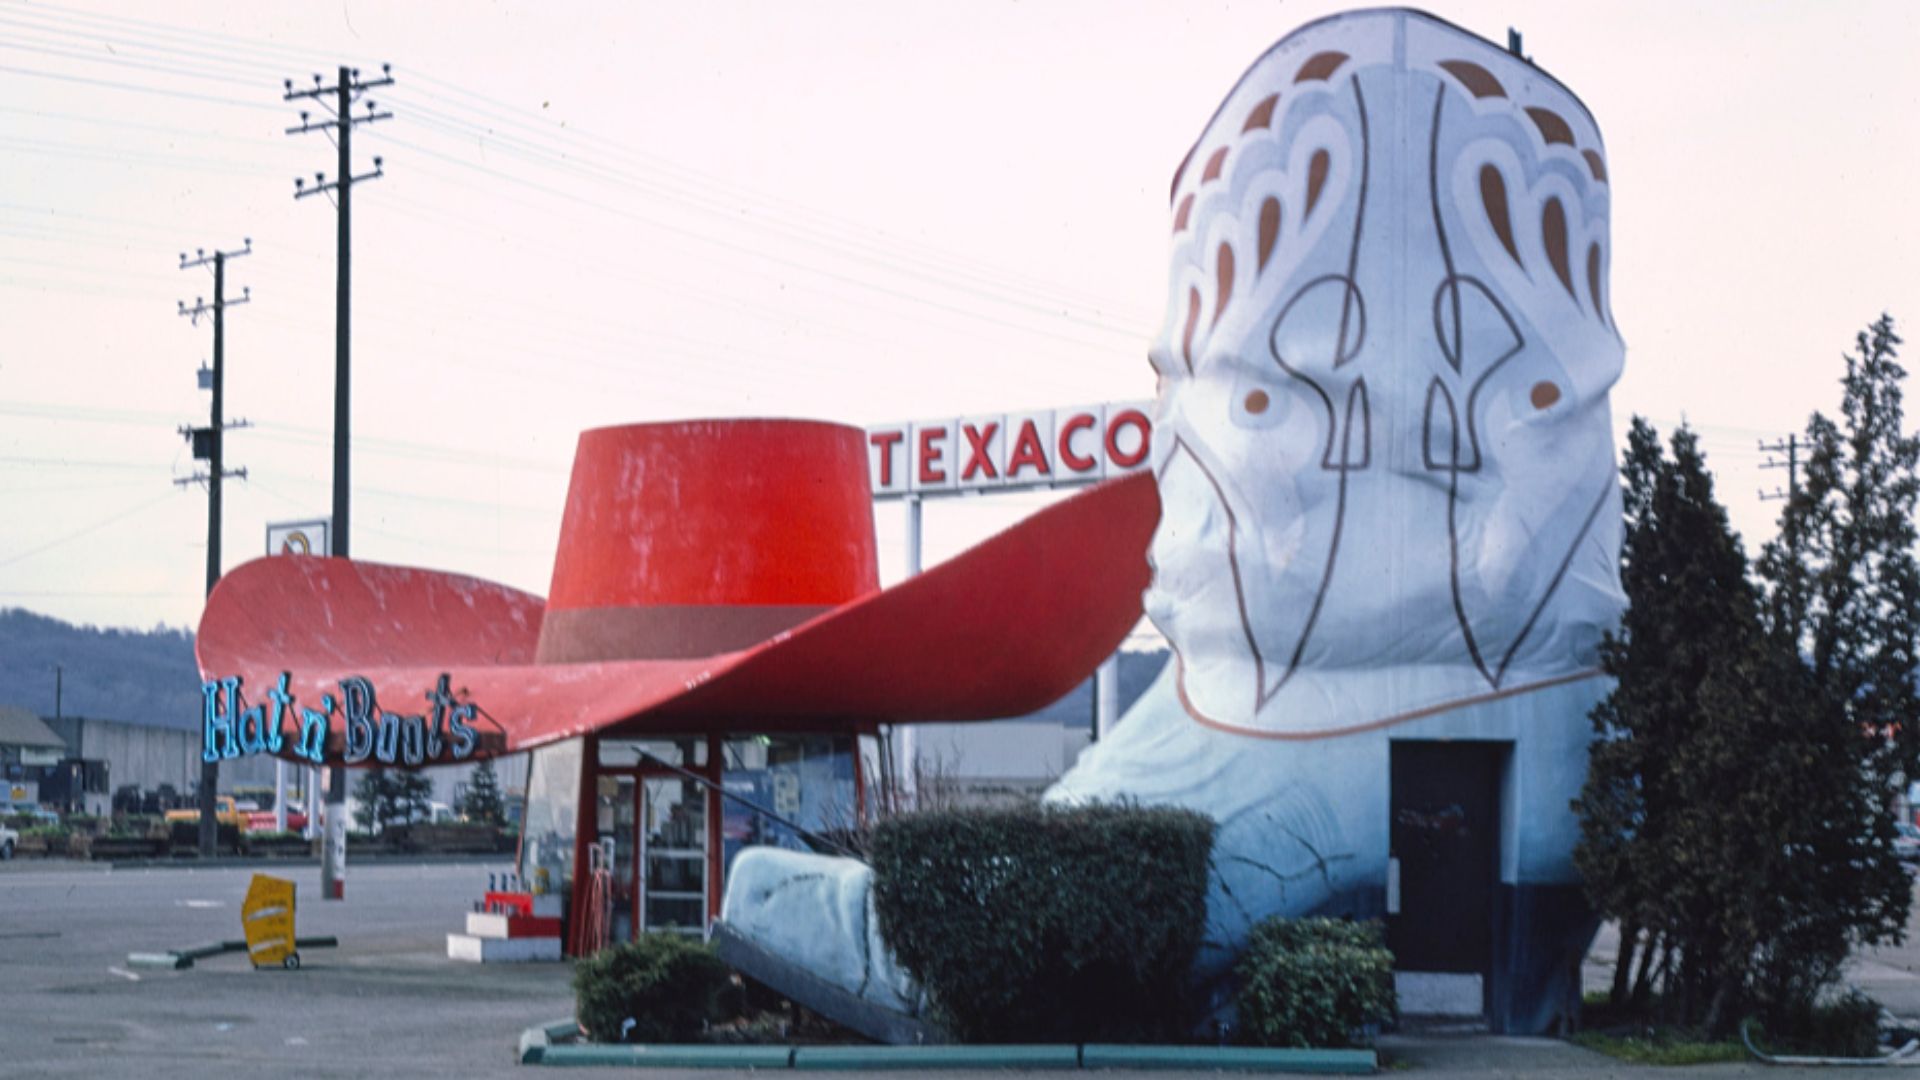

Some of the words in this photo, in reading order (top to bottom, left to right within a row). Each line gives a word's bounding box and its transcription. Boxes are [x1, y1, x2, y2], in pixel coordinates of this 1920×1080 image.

[871, 409, 1151, 486] TEXACO
[202, 672, 292, 763] Hat
[339, 673, 478, 765] Boots
